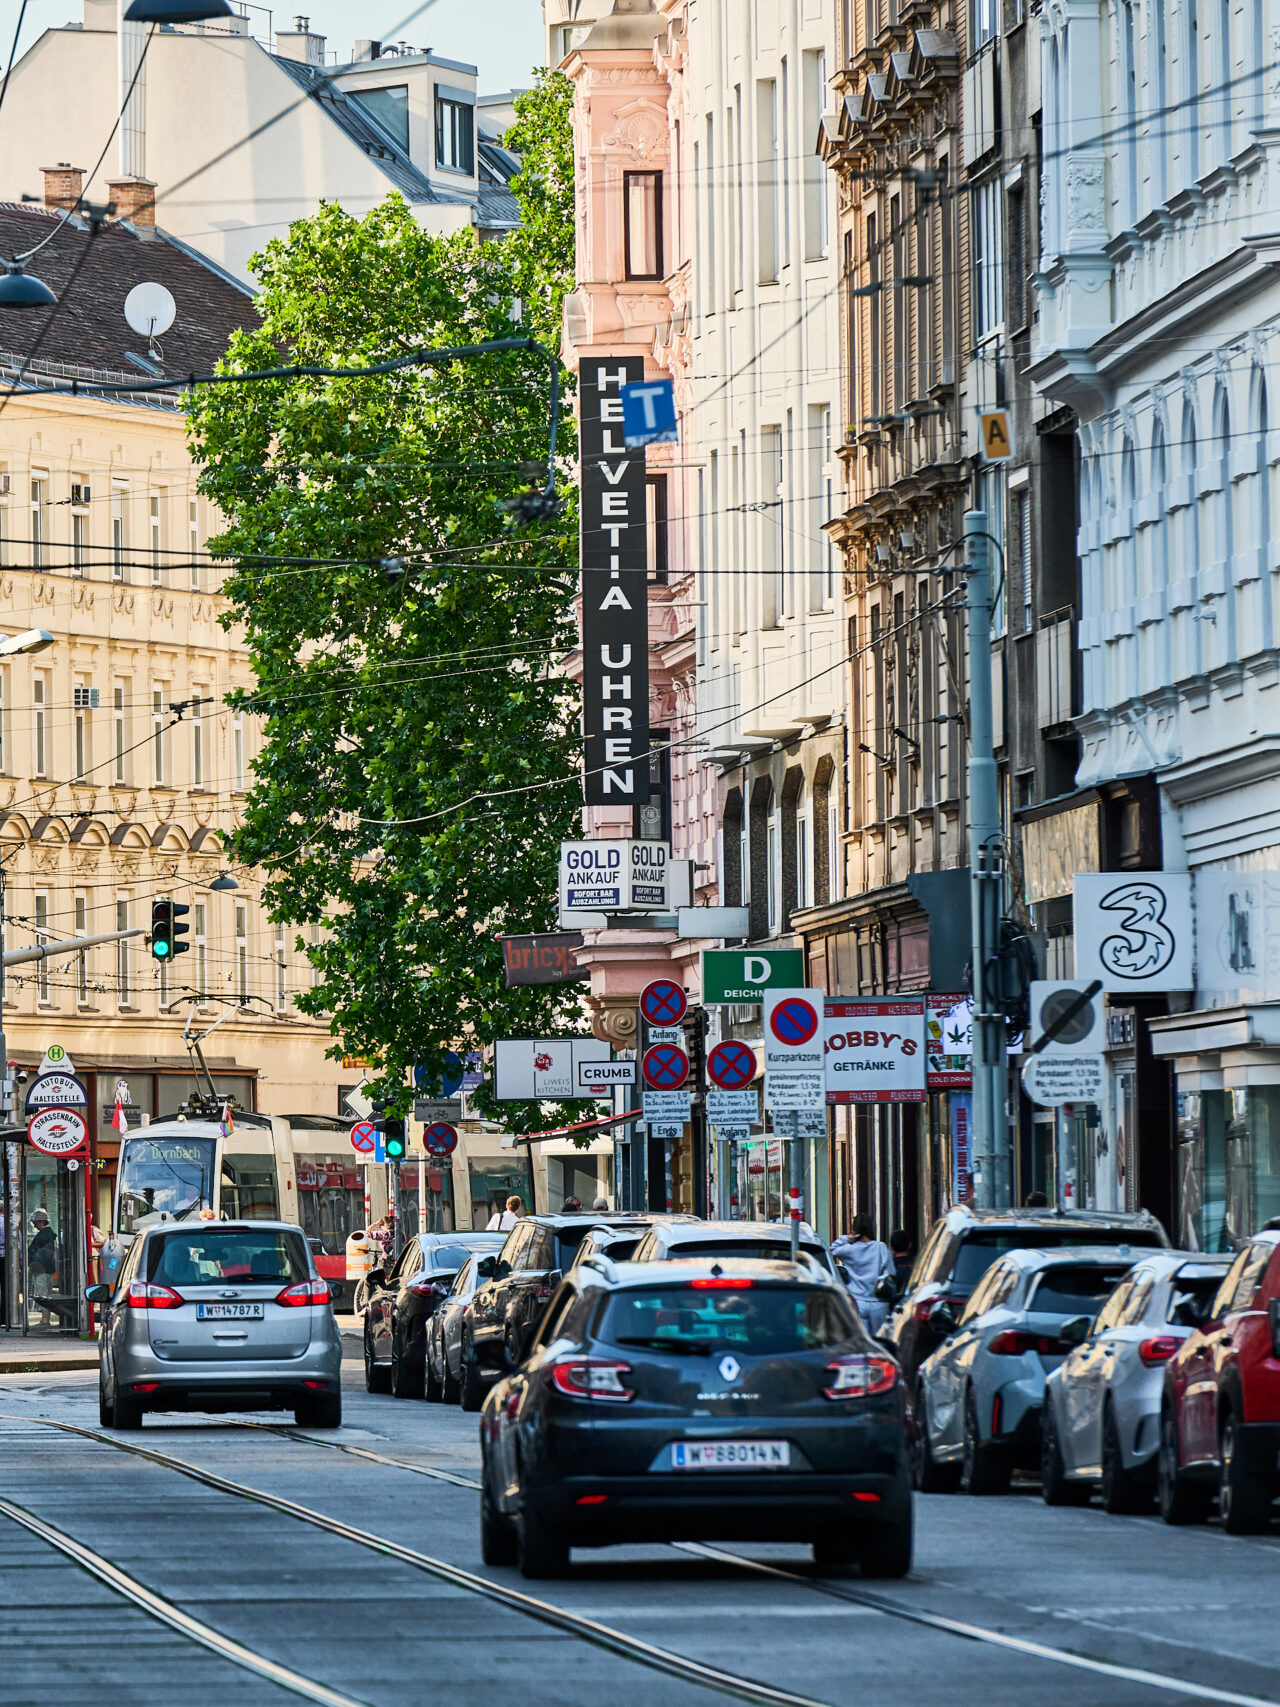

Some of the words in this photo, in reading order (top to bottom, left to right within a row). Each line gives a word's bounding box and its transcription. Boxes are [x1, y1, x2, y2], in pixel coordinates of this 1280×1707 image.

[629, 386, 664, 429] T
[988, 419, 1006, 445] A
[596, 367, 632, 611] HELVETIA
[599, 643, 634, 794] UHREN
[567, 849, 620, 869] GOLD
[631, 845, 666, 867] GOLD
[567, 871, 620, 885] ANKAUF
[632, 868, 666, 882] ANKAUF
[573, 890, 599, 898] SOFORT
[636, 887, 652, 895] SOFORT
[652, 888, 662, 896] BAR
[571, 898, 617, 906] AUSZAHLUNG!
[506, 941, 578, 975] bricks
[744, 956, 772, 984] D
[52, 1048, 61, 1058] H
[768, 1052, 821, 1063] Kurzparkzone
[833, 1060, 895, 1071] GETRÄNKE
[40, 1077, 75, 1089] AUTOBUS
[537, 1086, 571, 1094] KITCHEN
[34, 1095, 80, 1103] HALTESTELLE
[34, 1112, 81, 1130] STRASSENBAHN
[37, 1135, 80, 1150] HALTESTELLE
[152, 1146, 201, 1159] Dornbach
[206, 1306, 213, 1315] W
[222, 1305, 251, 1315] 14787
[254, 1305, 260, 1314] R
[690, 1447, 701, 1461] W
[771, 1446, 781, 1460] N
